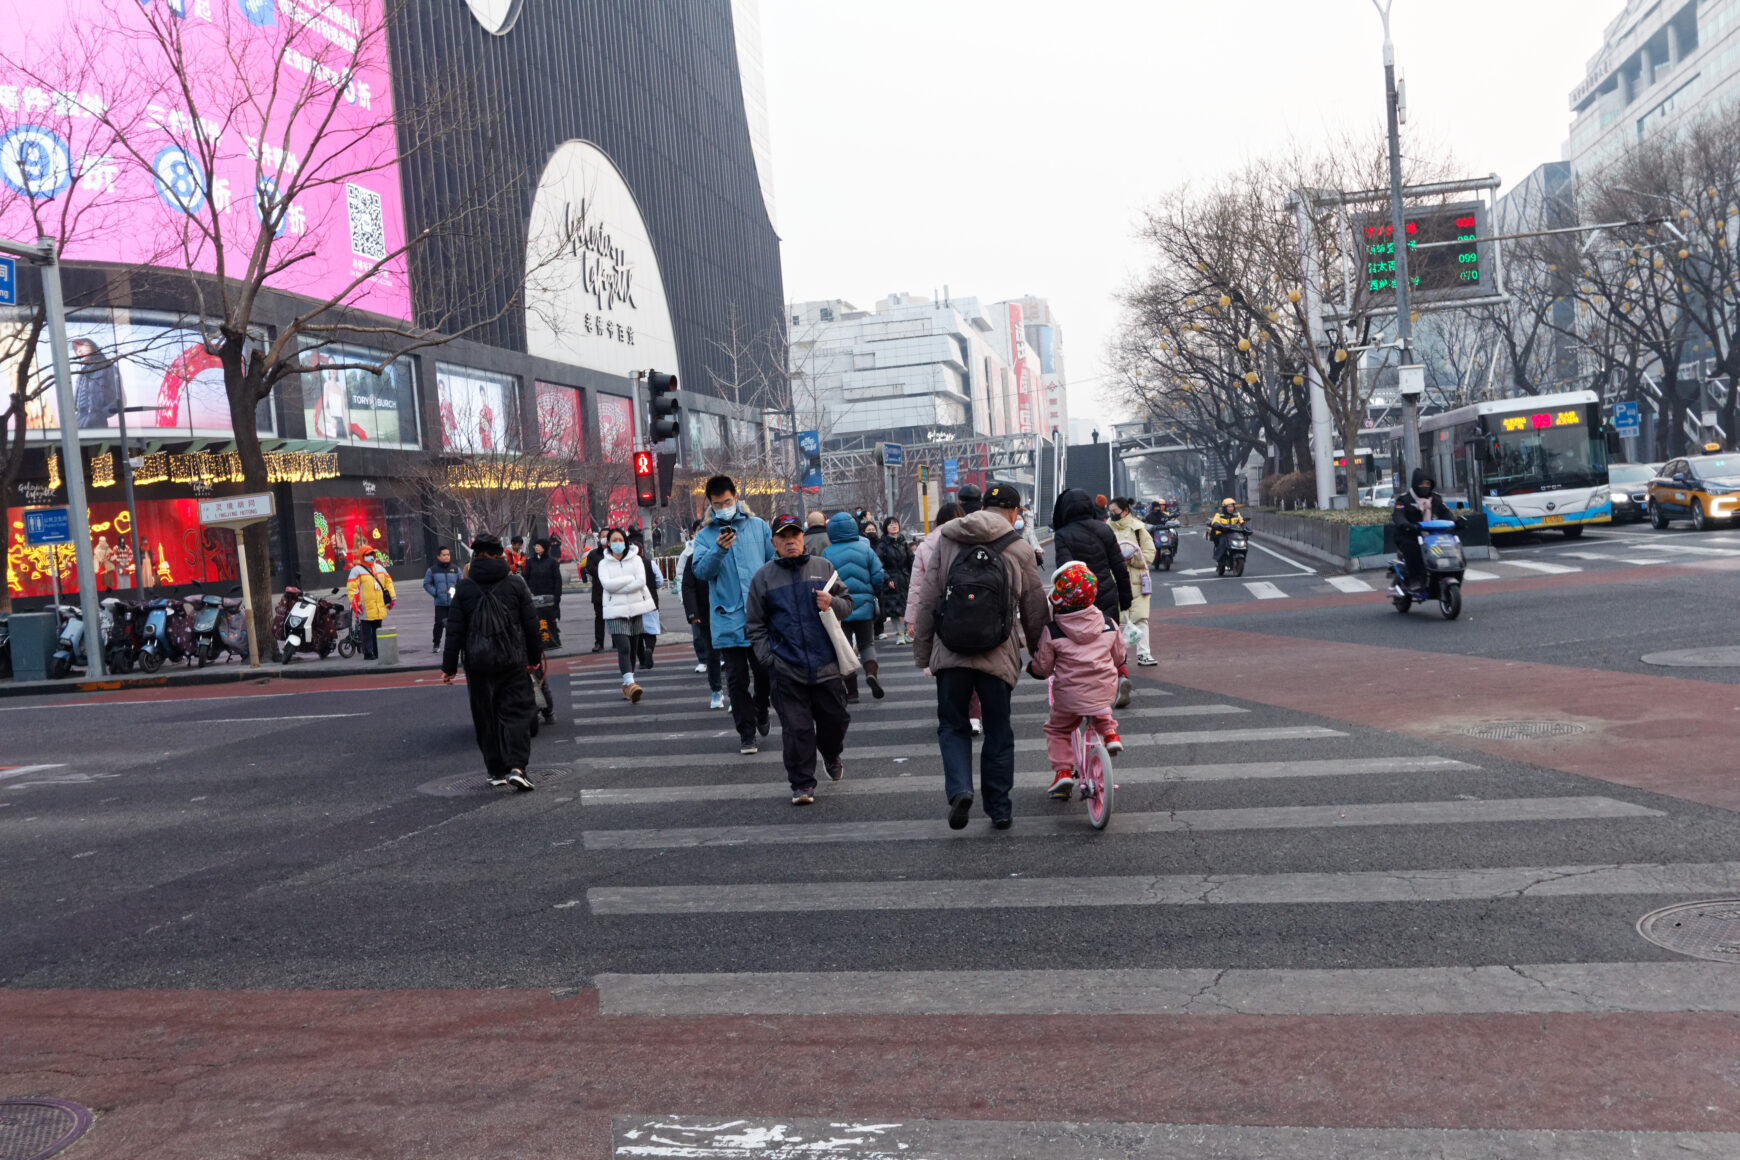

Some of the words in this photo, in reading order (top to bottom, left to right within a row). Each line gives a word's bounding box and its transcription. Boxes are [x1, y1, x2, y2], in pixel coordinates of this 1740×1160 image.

[19, 140, 50, 181] 9
[170, 160, 193, 198] 8
[1456, 216, 1475, 228] 000
[1458, 252, 1477, 263] 099
[352, 394, 369, 406] TORY
[376, 398, 397, 409] BURCH
[1615, 404, 1626, 417] P
